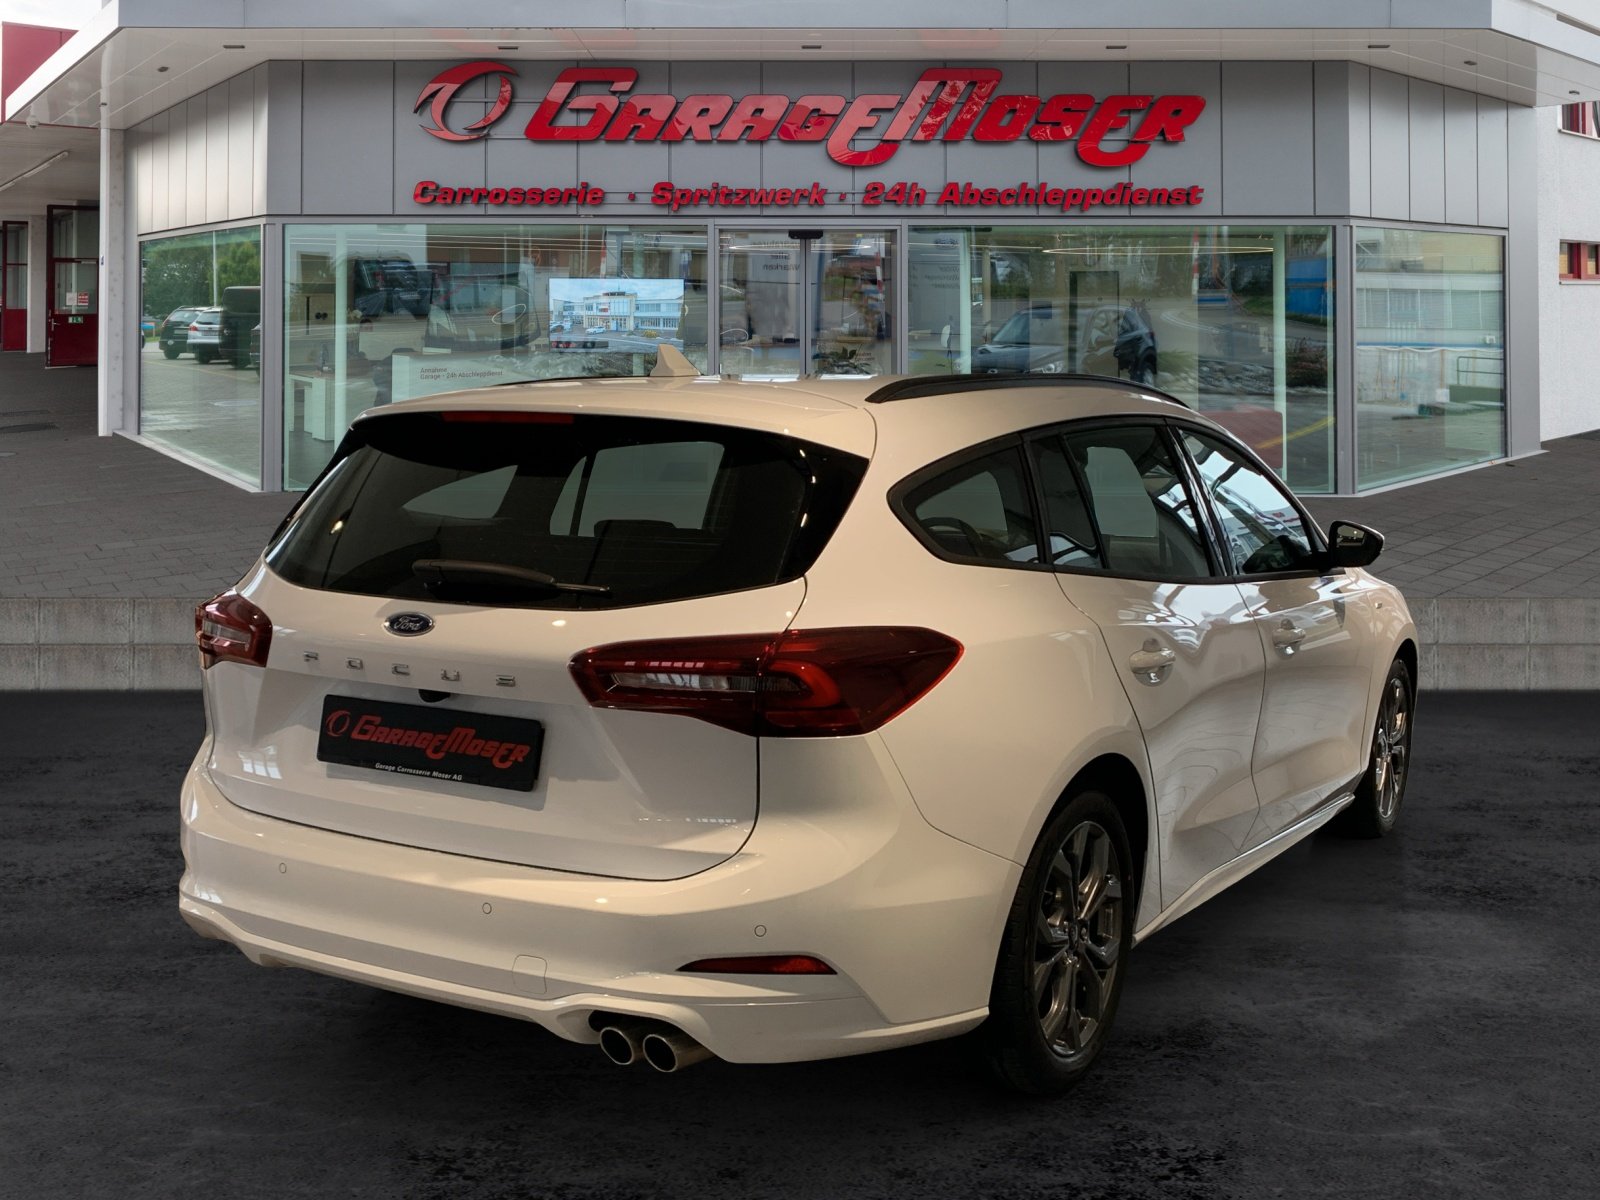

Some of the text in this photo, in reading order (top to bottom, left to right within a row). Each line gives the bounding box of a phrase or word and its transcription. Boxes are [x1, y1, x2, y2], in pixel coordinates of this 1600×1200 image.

[413, 181, 1204, 211] Carrosserie Spritzwerk 24h Abschleppdienst
[393, 615, 424, 631] Ford
[304, 651, 516, 687] FOCUS
[375, 763, 395, 771] Garage
[397, 766, 431, 776] Carrosserie
[431, 771, 452, 779] Moser
